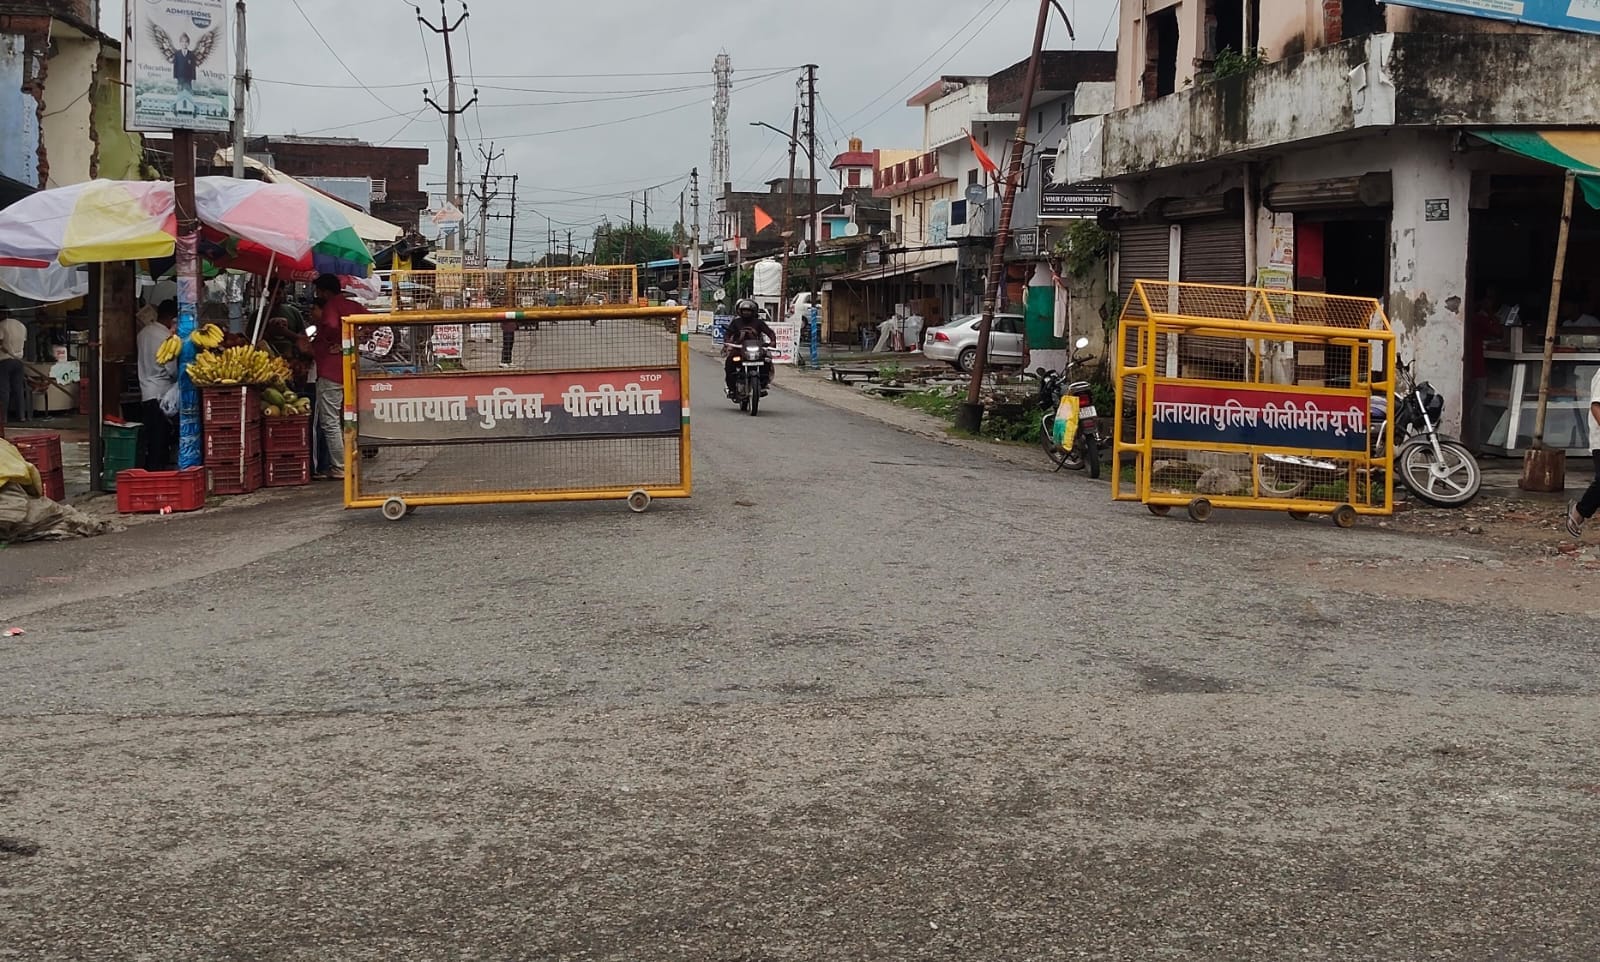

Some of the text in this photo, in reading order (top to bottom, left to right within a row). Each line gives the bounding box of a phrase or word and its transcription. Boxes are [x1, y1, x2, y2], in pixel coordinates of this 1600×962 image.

[165, 8, 212, 18] ADMISSIONS
[1084, 196, 1108, 204] THERAPY
[640, 374, 662, 382] STOP
[370, 383, 662, 430] यातायात पुलिस, पीलीभीत
[1212, 398, 1260, 431] पुलिस
[1261, 400, 1330, 432] पीलीभीत
